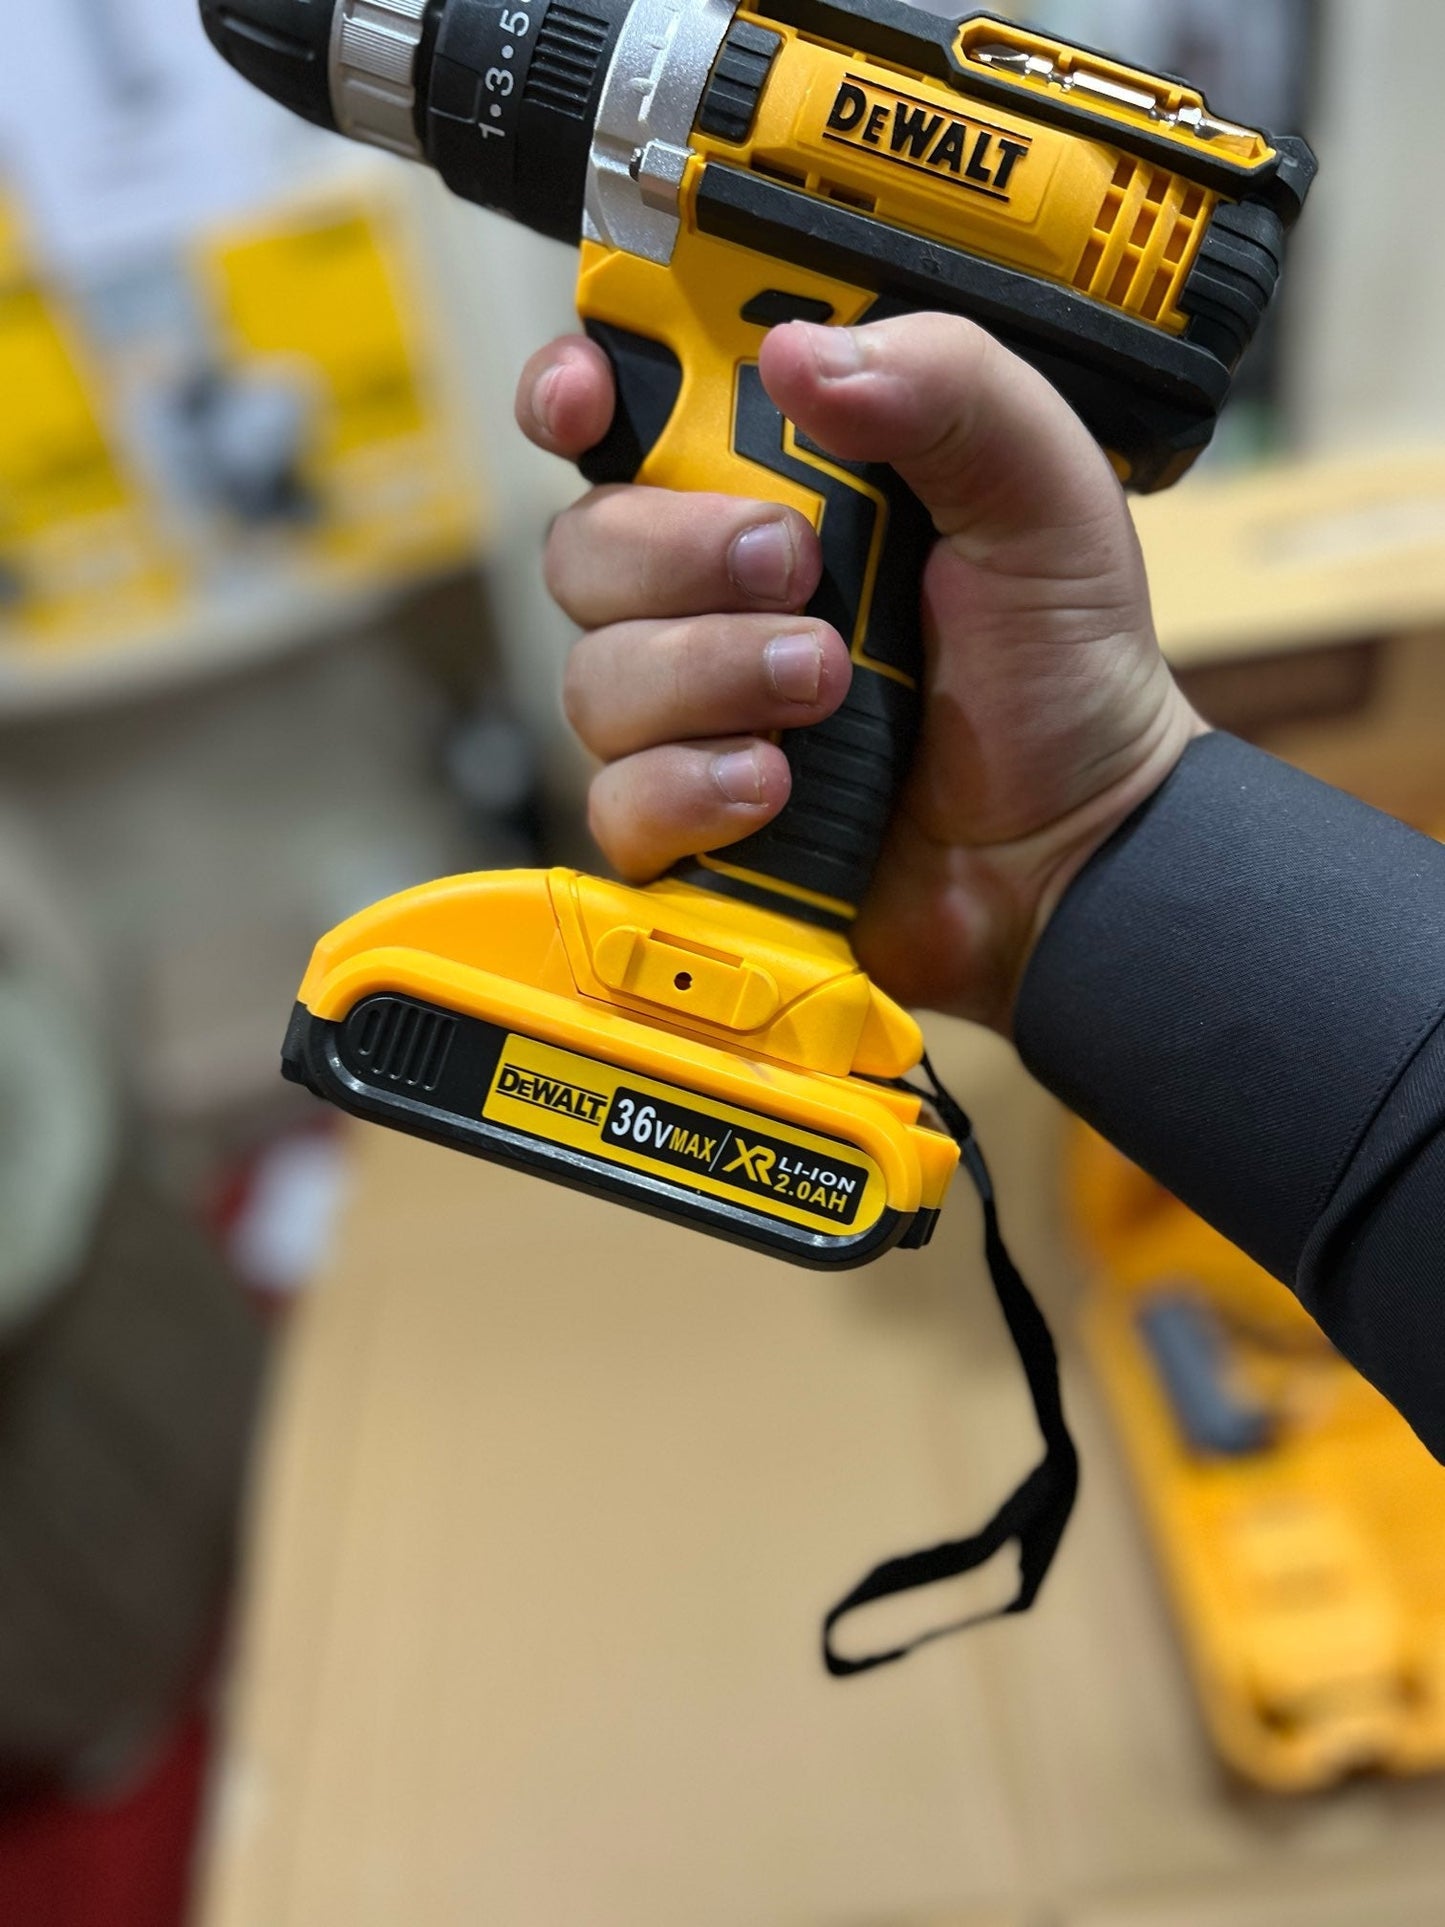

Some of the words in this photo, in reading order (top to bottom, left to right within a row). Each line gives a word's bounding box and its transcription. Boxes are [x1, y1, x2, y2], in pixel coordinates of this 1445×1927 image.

[722, 1137, 776, 1186] XR
[778, 1156, 857, 1194] LI-ION
[773, 1174, 848, 1213] 2.0AH
